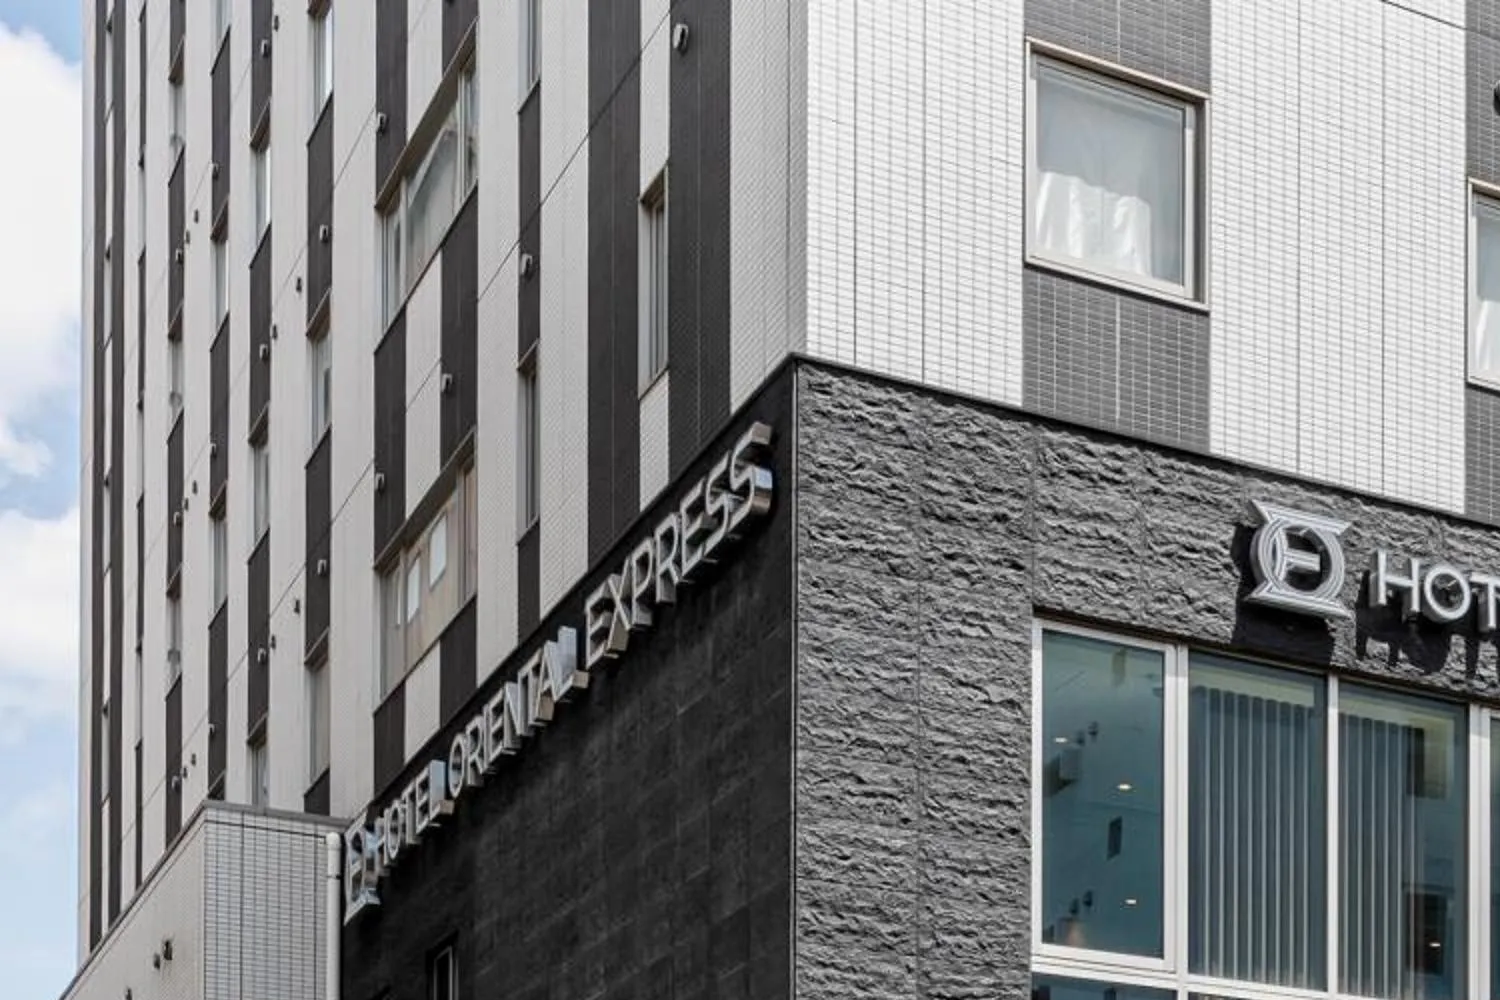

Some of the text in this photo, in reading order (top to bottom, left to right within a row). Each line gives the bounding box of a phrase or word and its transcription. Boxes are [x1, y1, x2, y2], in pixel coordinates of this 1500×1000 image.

[374, 421, 774, 877] HOTEL ORIENTAL EXPRESS
